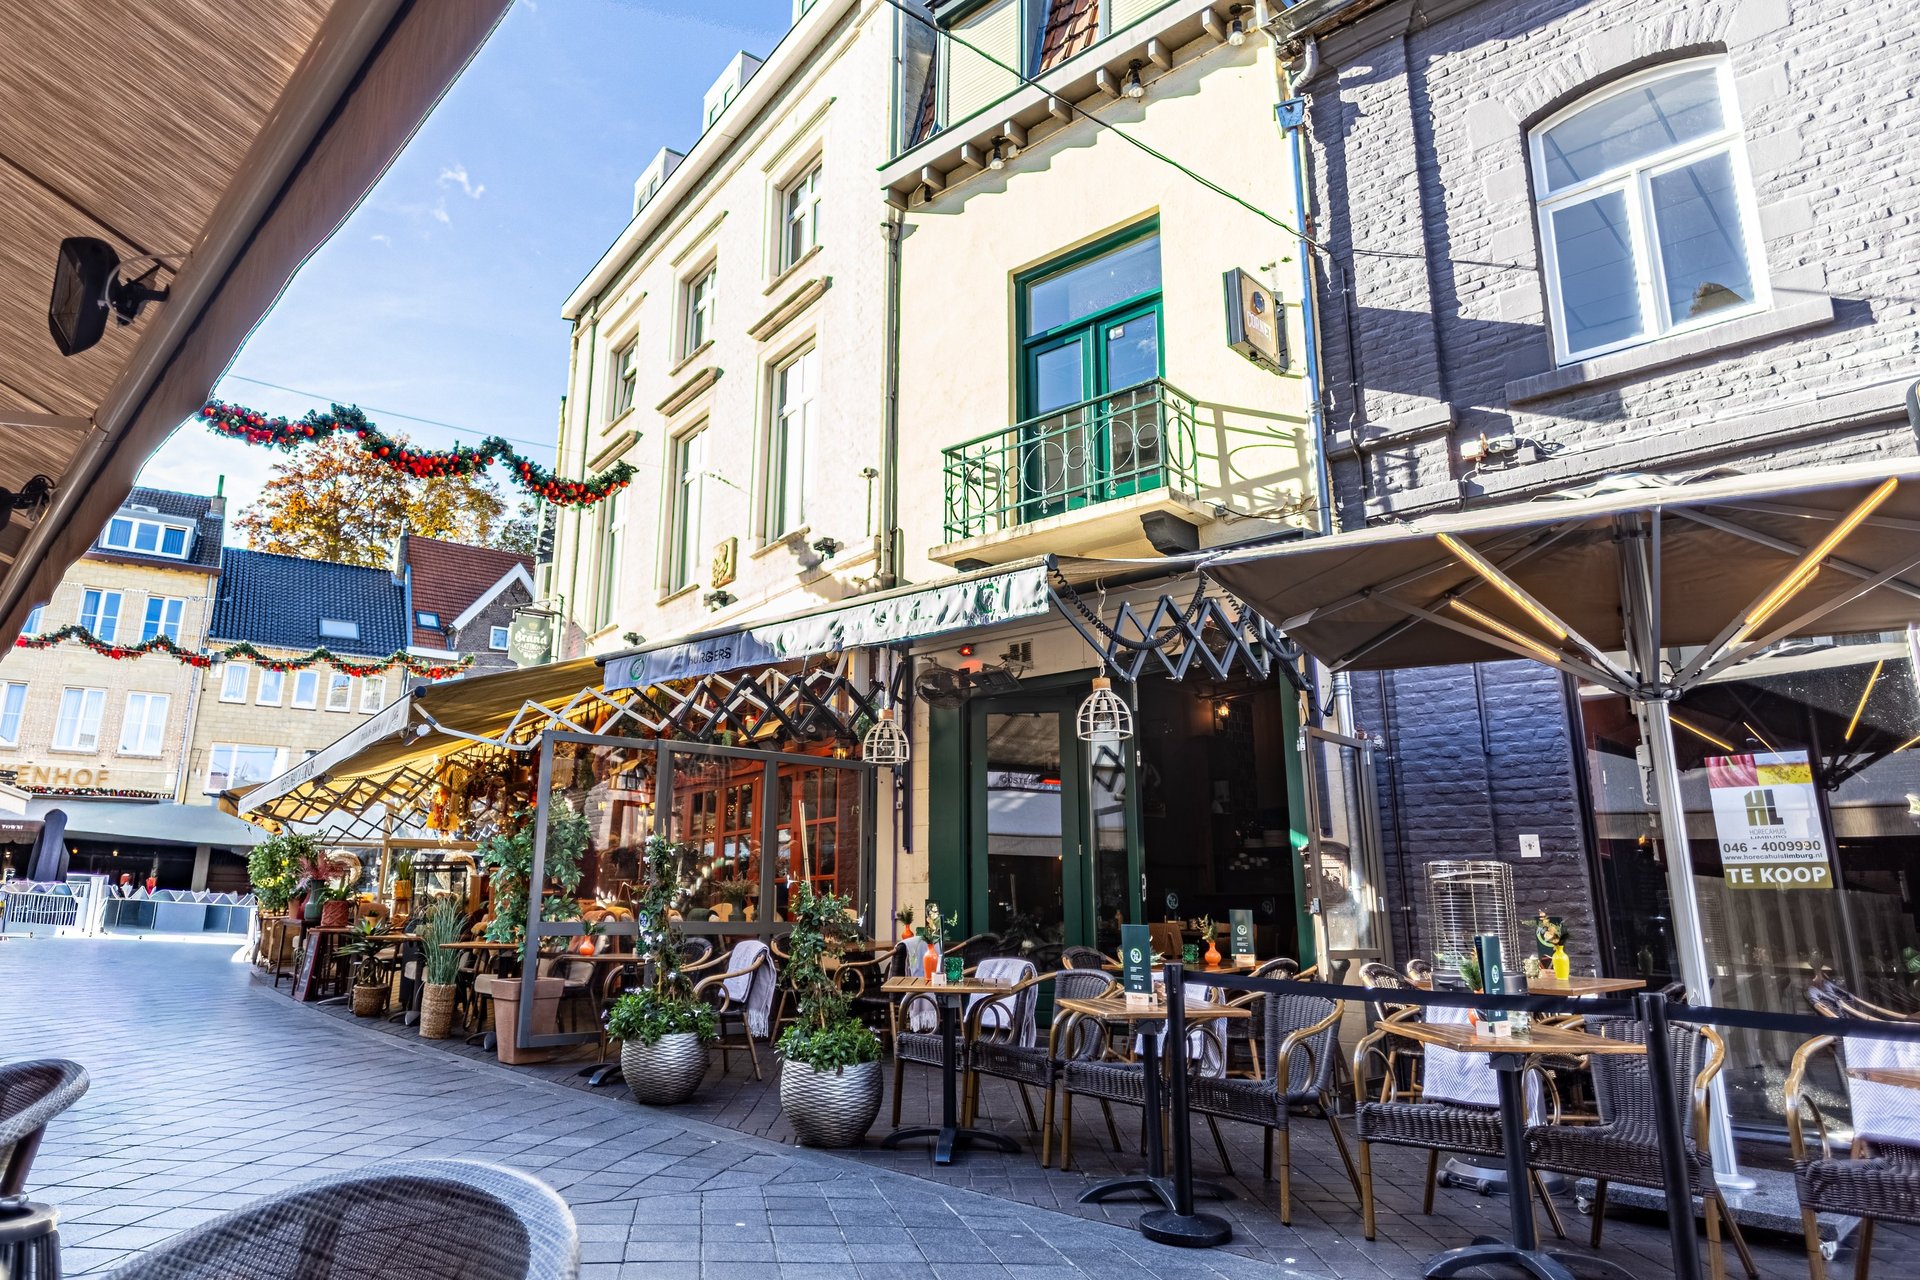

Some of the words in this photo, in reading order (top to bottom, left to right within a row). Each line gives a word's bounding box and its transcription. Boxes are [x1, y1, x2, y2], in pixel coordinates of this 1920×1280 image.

[1723, 842, 1748, 853] 046
[1761, 840, 1821, 852] 4009990
[1725, 853, 1823, 861] www.horecahuislimburg.nl
[1726, 868, 1754, 884] TE
[1760, 866, 1826, 884] KOOP
